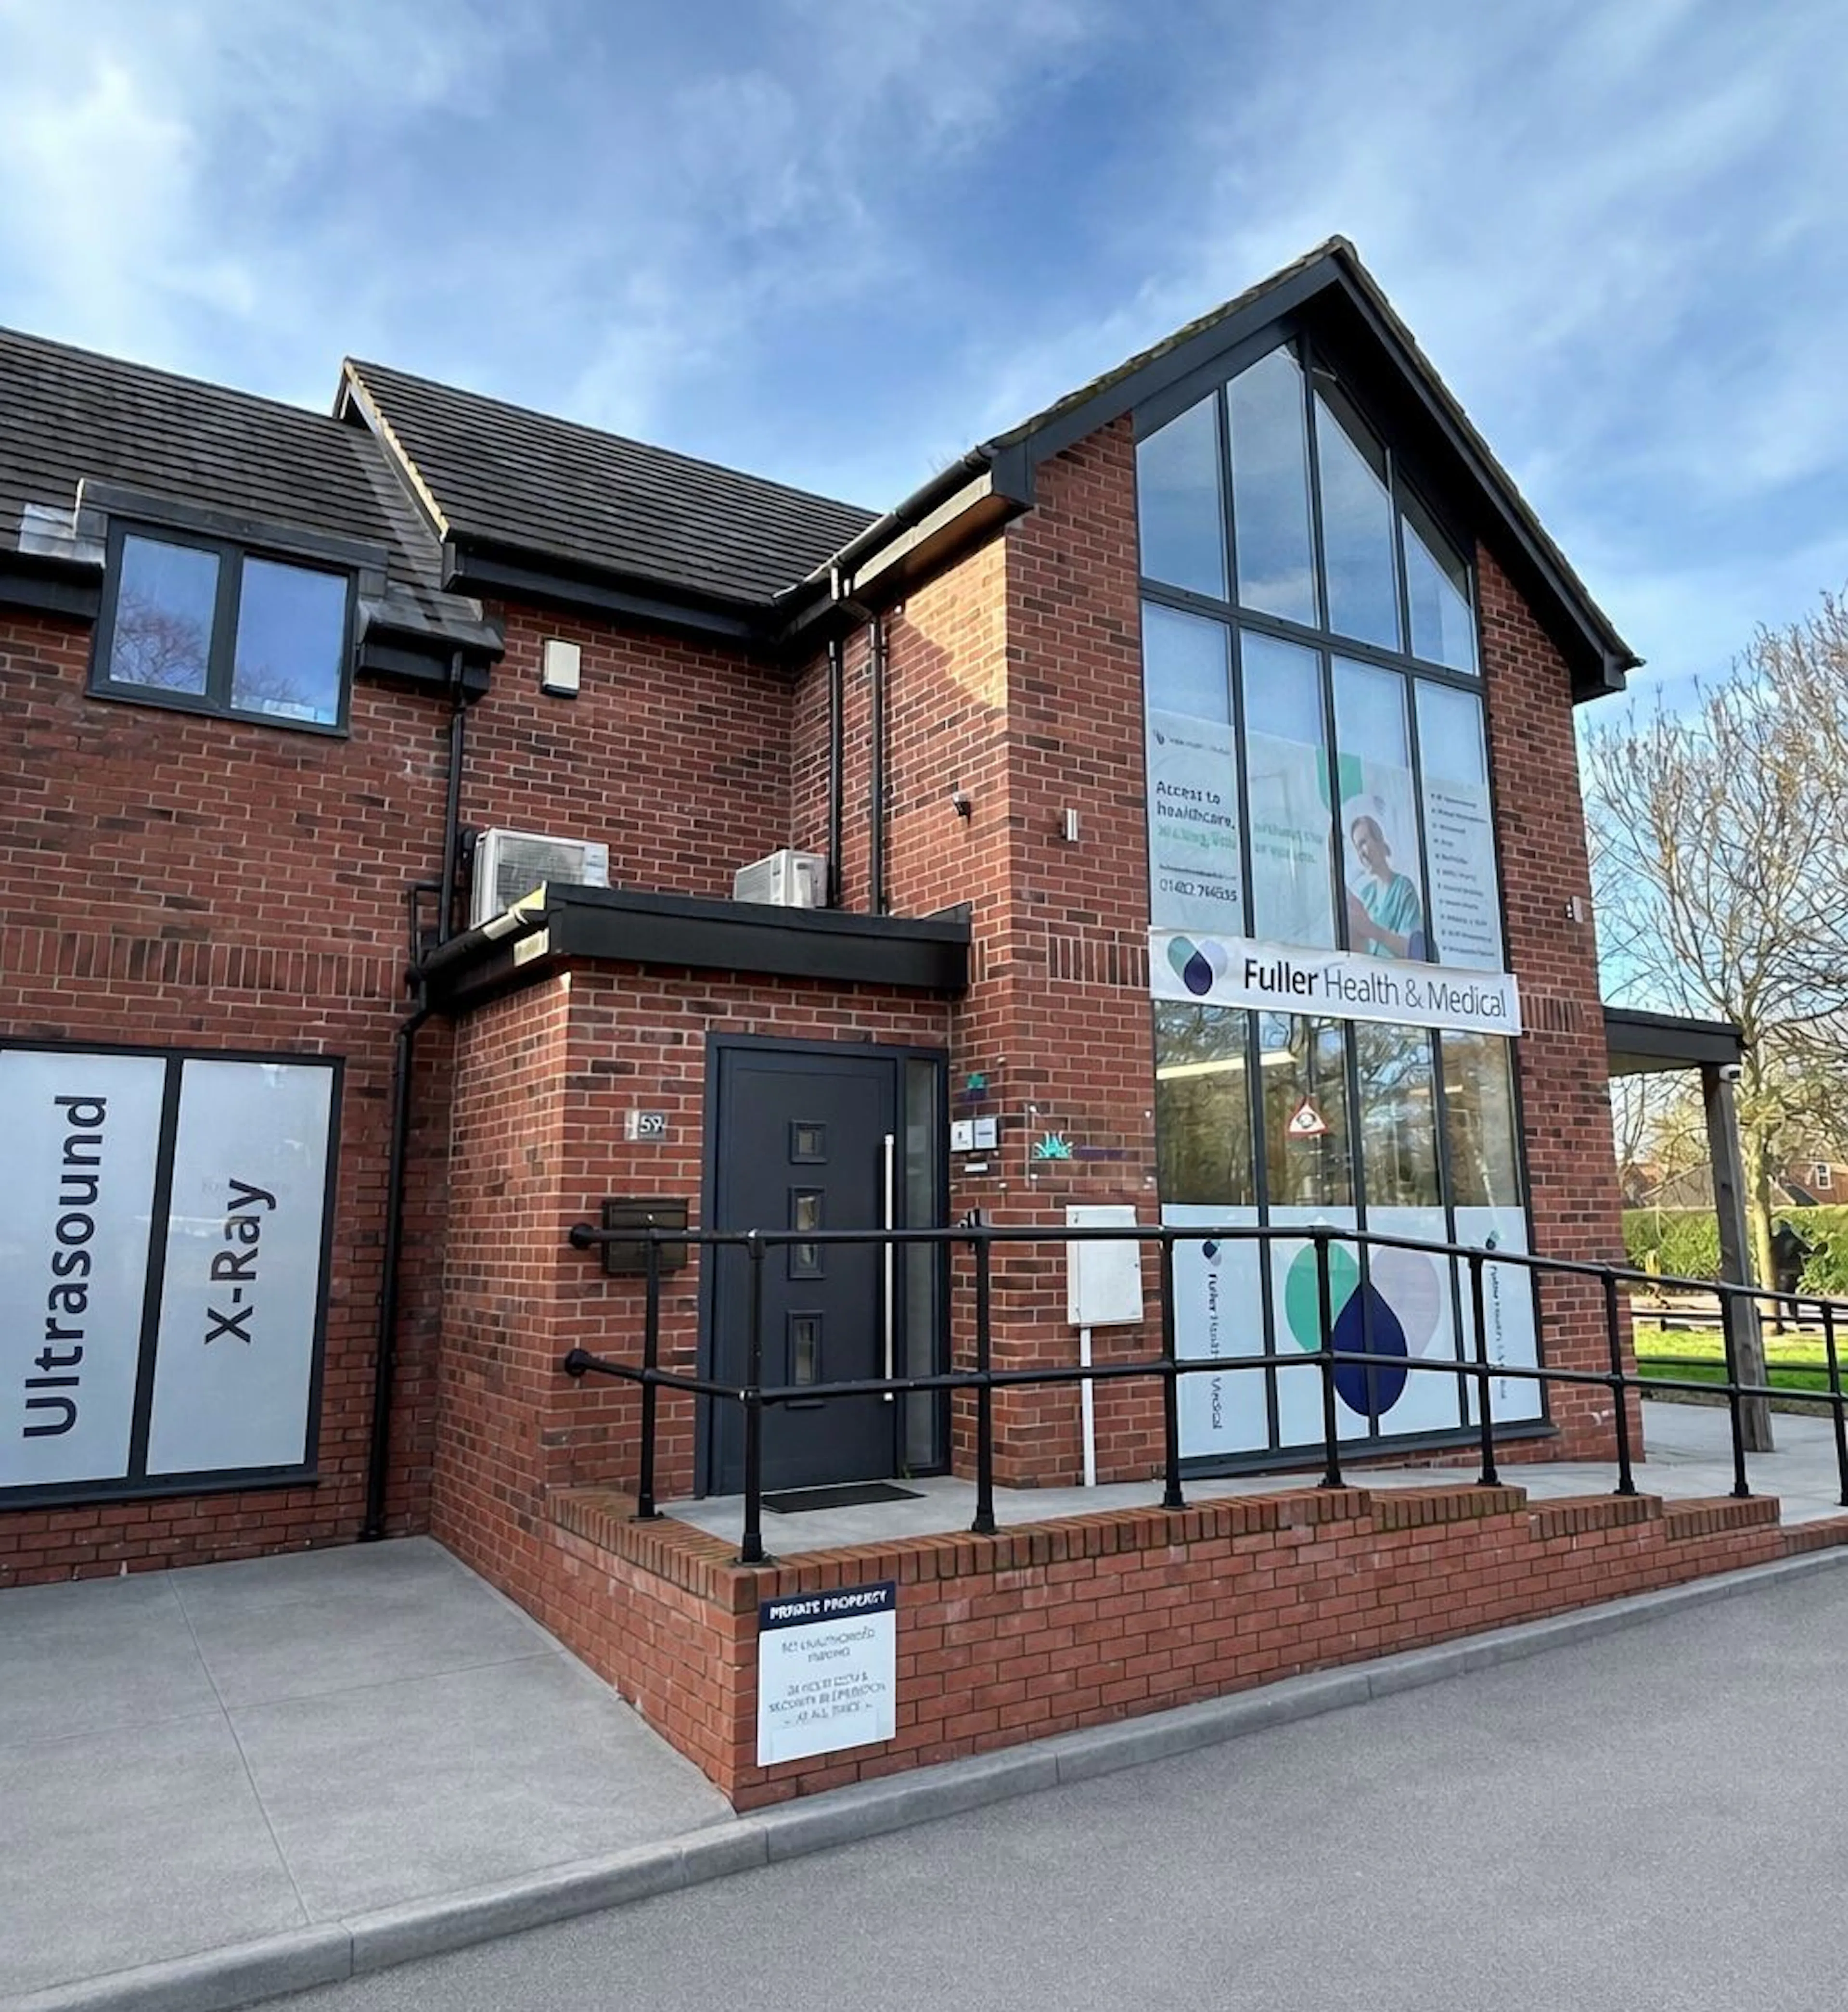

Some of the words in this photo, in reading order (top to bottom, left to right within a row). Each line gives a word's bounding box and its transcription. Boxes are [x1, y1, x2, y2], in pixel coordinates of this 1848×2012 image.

[1206, 792, 1220, 804] to
[1245, 958, 1319, 996] Fuller
[1324, 968, 1399, 1006] Health
[1405, 979, 1424, 1009] &
[1427, 981, 1506, 1017] Medical
[23, 1096, 106, 1438] Ultrasound
[204, 1179, 276, 1344] X-Ray
